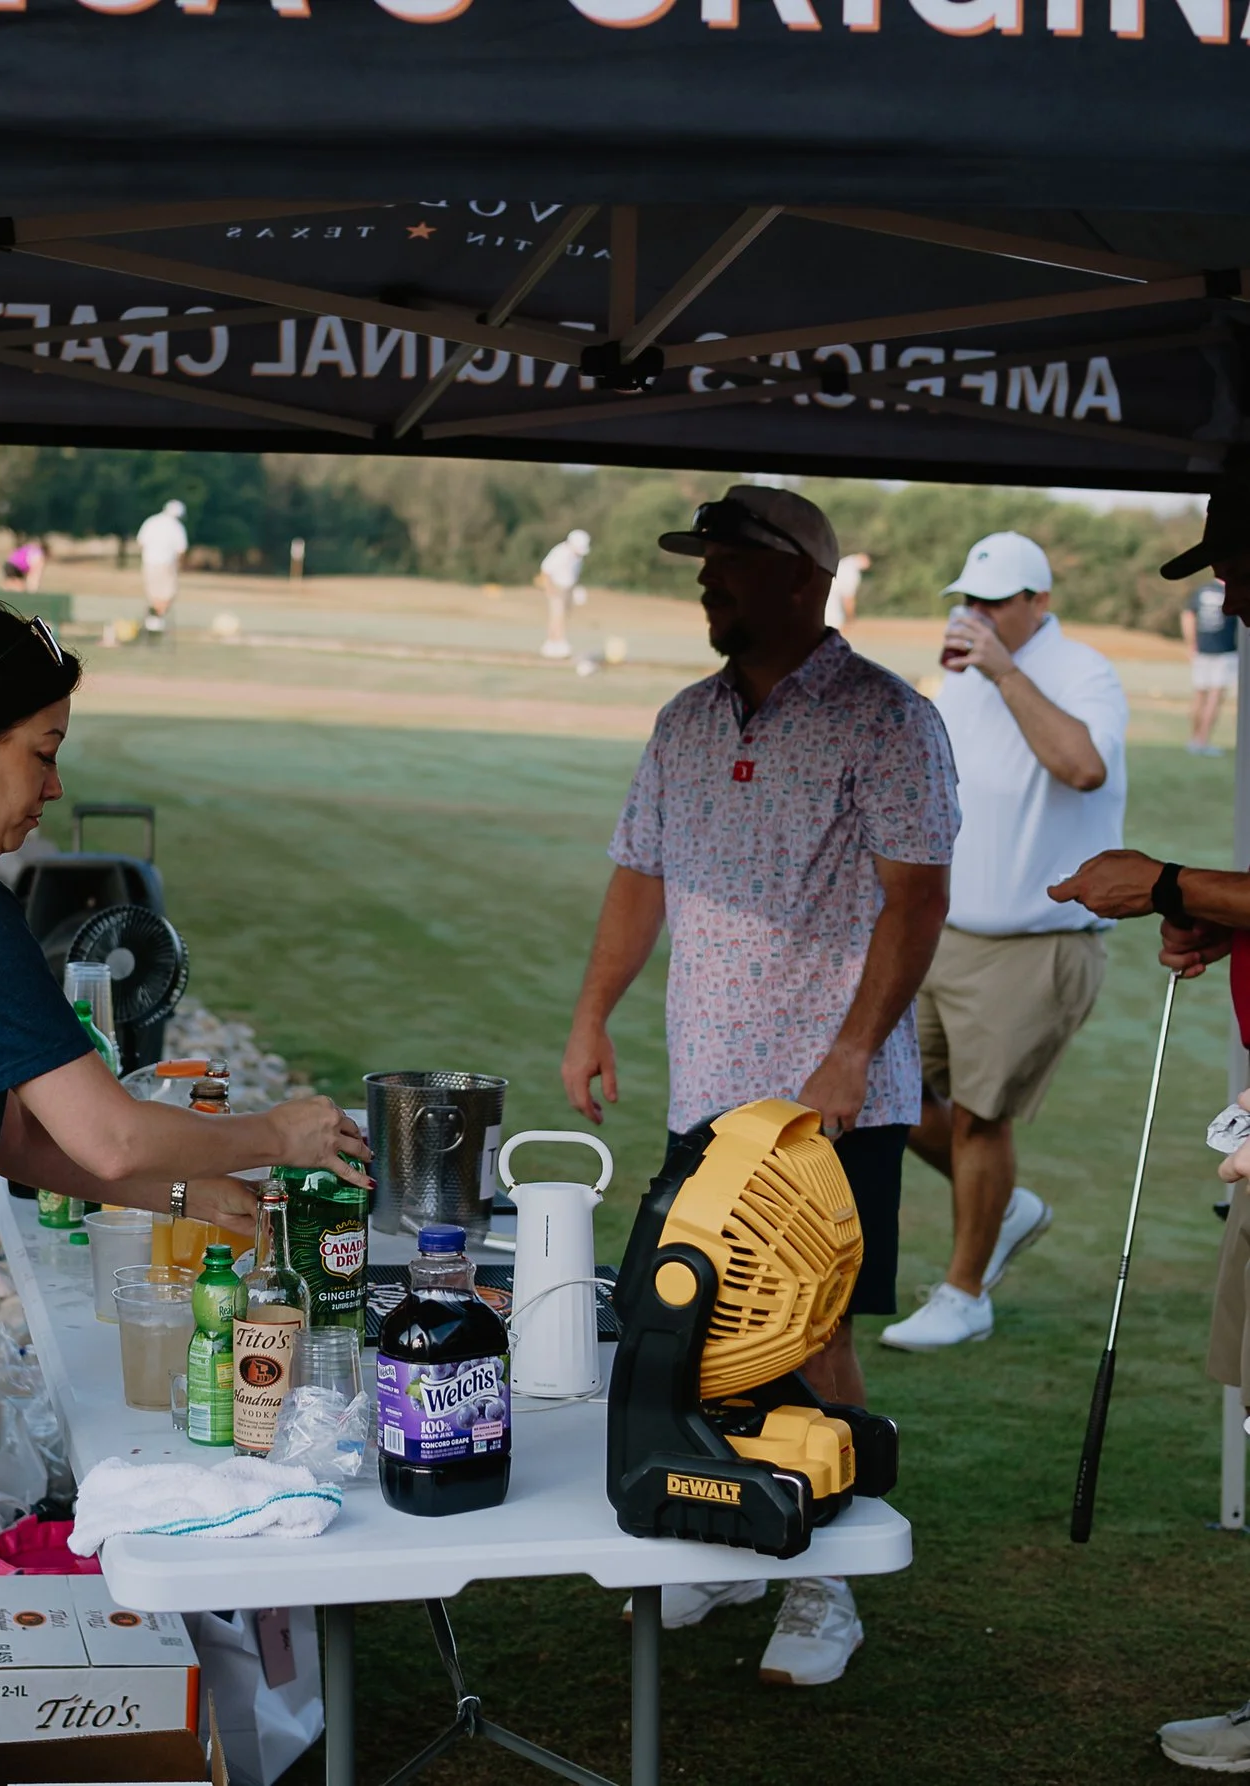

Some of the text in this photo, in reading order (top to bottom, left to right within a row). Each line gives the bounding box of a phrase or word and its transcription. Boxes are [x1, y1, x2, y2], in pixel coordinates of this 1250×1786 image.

[336, 1253, 360, 1268] DRY
[319, 1290, 355, 1301] GINGER
[236, 1326, 290, 1350] Tito's
[424, 1367, 494, 1413] Welch's
[233, 1388, 282, 1407] Handma
[242, 1408, 277, 1420] VODKA
[420, 1420, 451, 1434] 100%
[420, 1432, 439, 1440] GRAPE
[420, 1436, 469, 1449] CONCORD GRAPE
